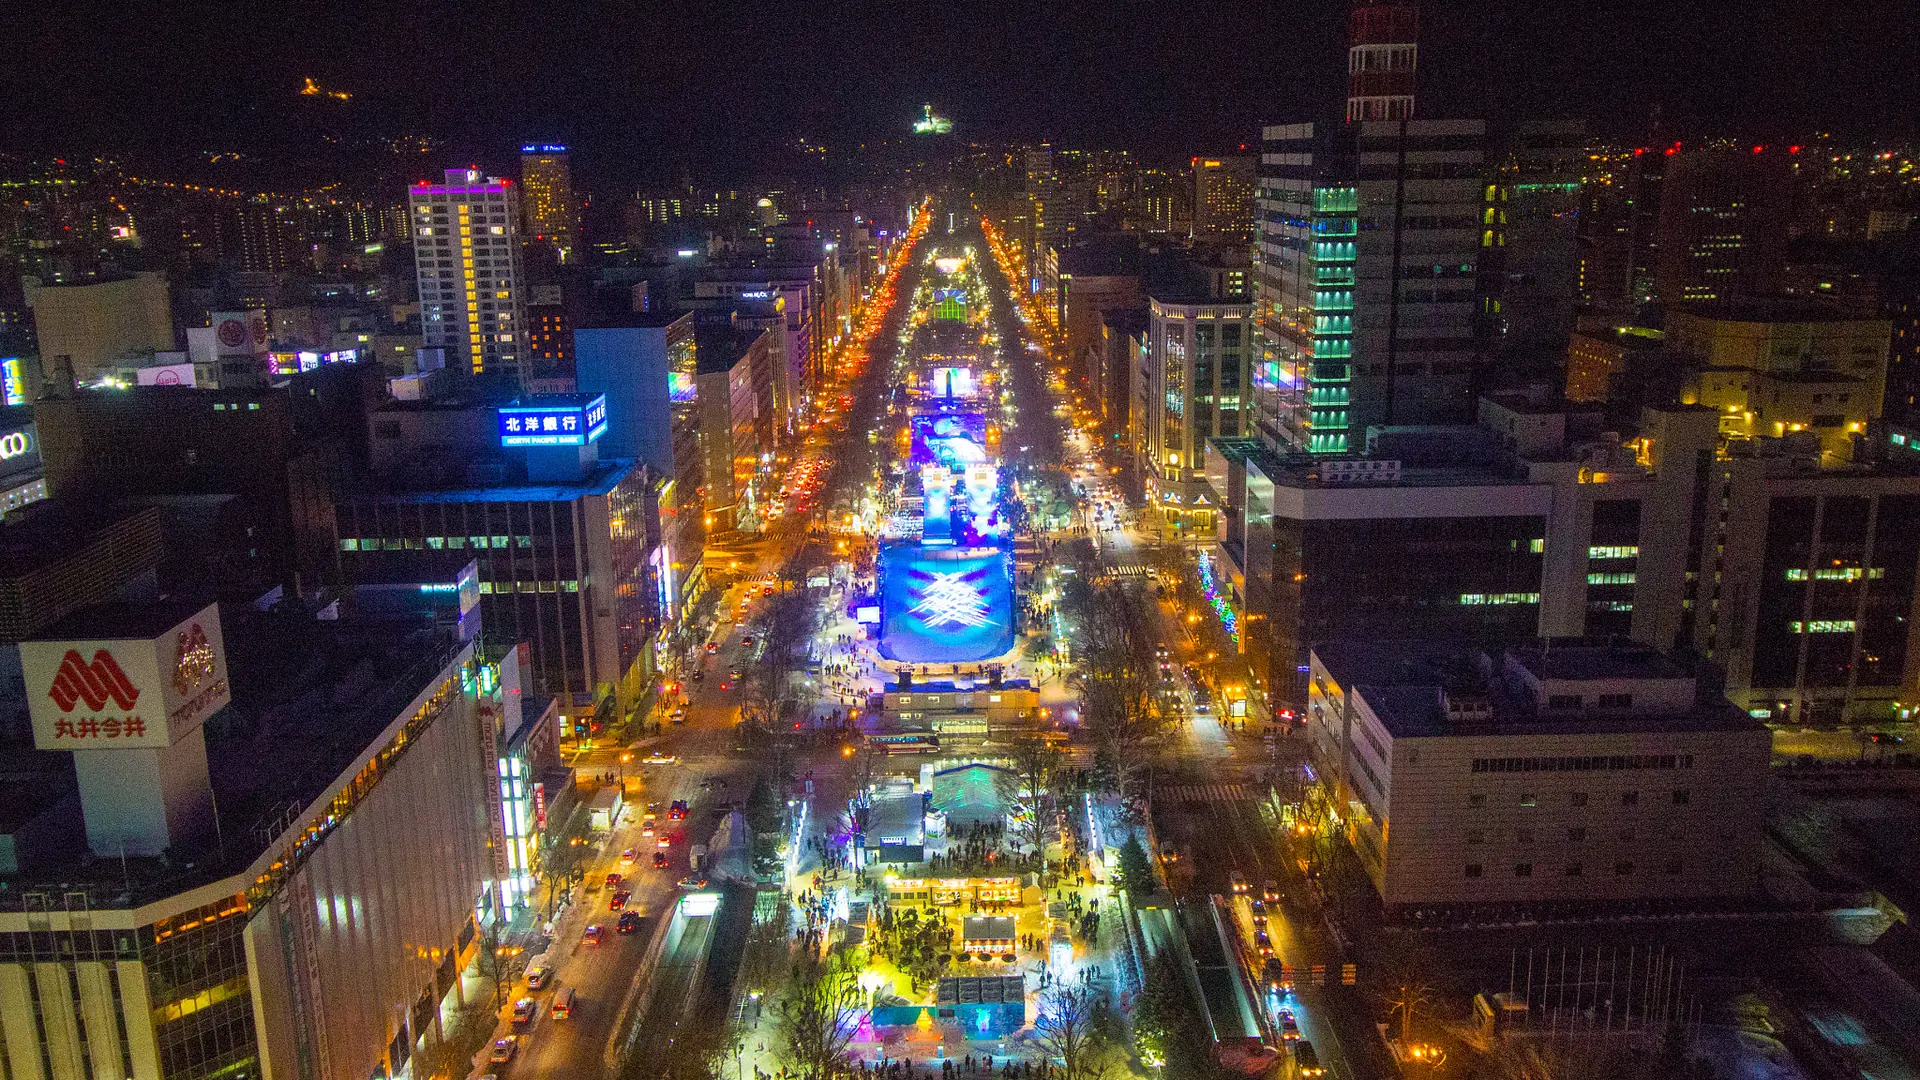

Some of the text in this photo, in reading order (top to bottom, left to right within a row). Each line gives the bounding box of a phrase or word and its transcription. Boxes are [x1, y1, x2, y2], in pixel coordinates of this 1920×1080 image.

[506, 416, 577, 432] 北洋銀行
[507, 437, 530, 445] NORTH
[55, 716, 147, 739] 丸井今井
